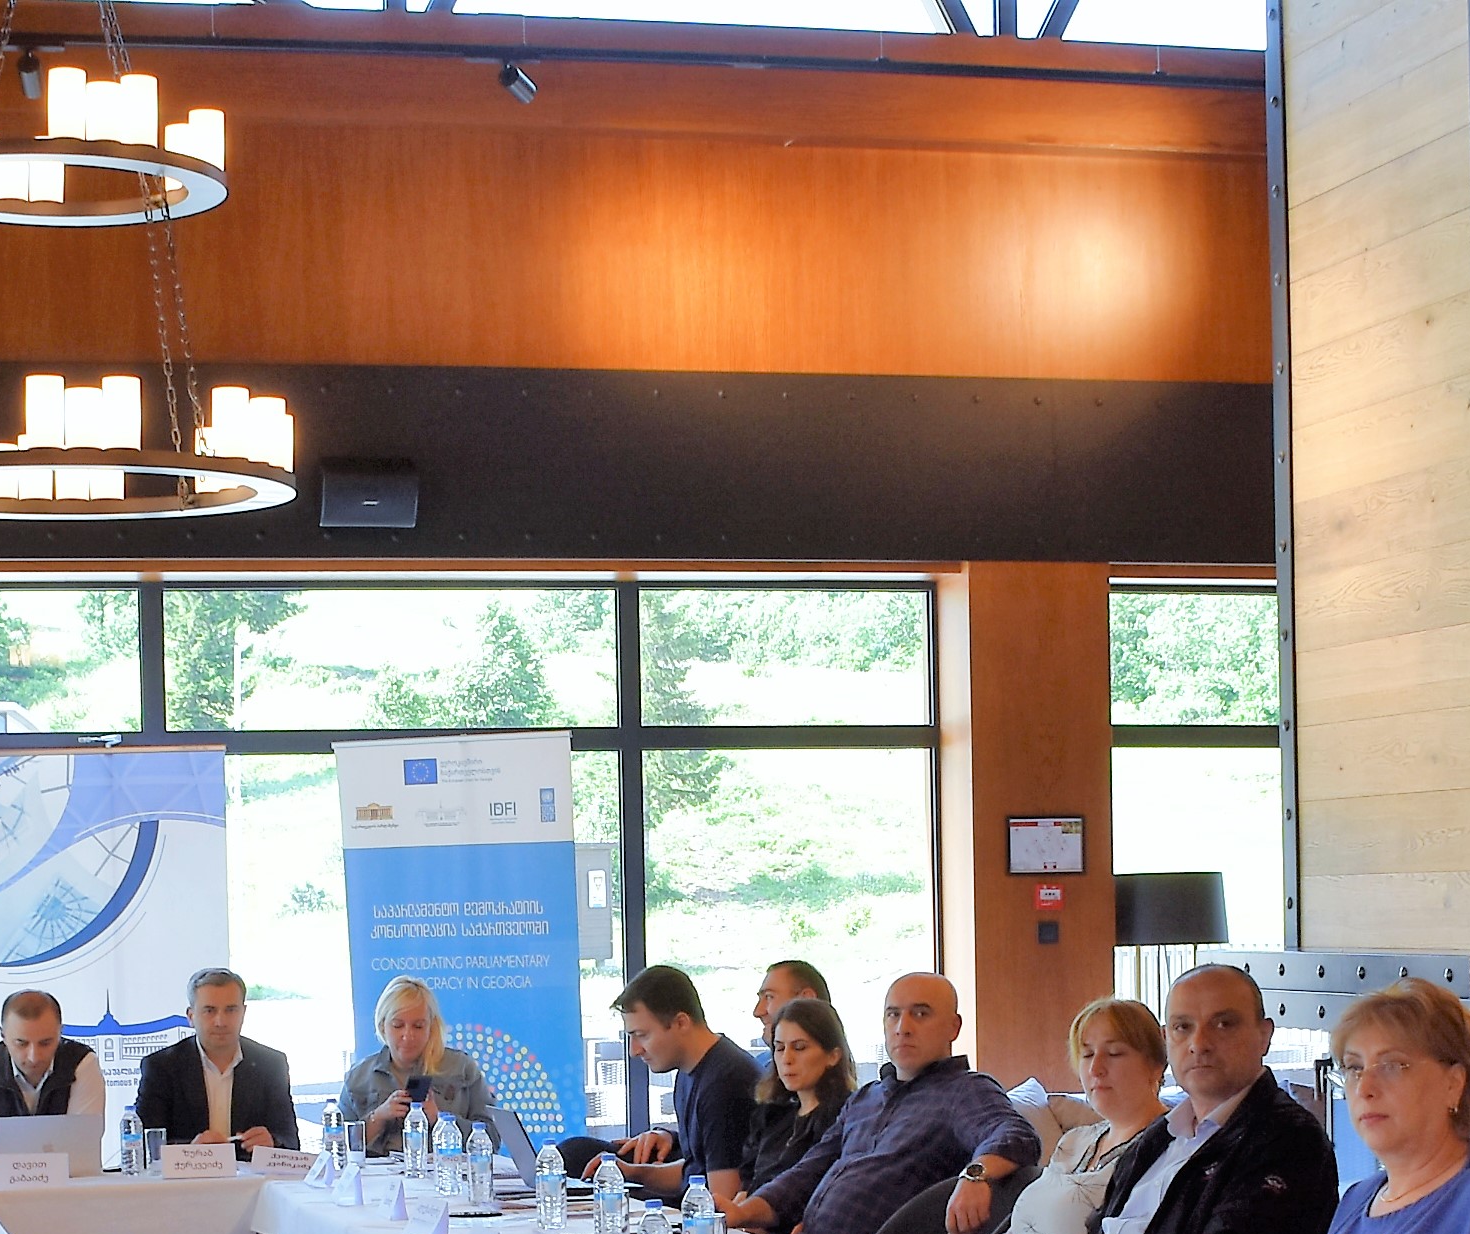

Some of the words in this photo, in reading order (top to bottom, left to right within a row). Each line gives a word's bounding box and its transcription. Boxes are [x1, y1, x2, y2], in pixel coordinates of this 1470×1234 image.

[489, 801, 517, 816] IDFI
[371, 955, 463, 972] CONSOLIDATING
[465, 953, 551, 970] PARLIAMENTARY
[466, 975, 479, 990] IN
[481, 974, 533, 990] GEORGIA
[12, 1162, 47, 1170] დავით
[9, 1174, 49, 1184] გაბაიძე
